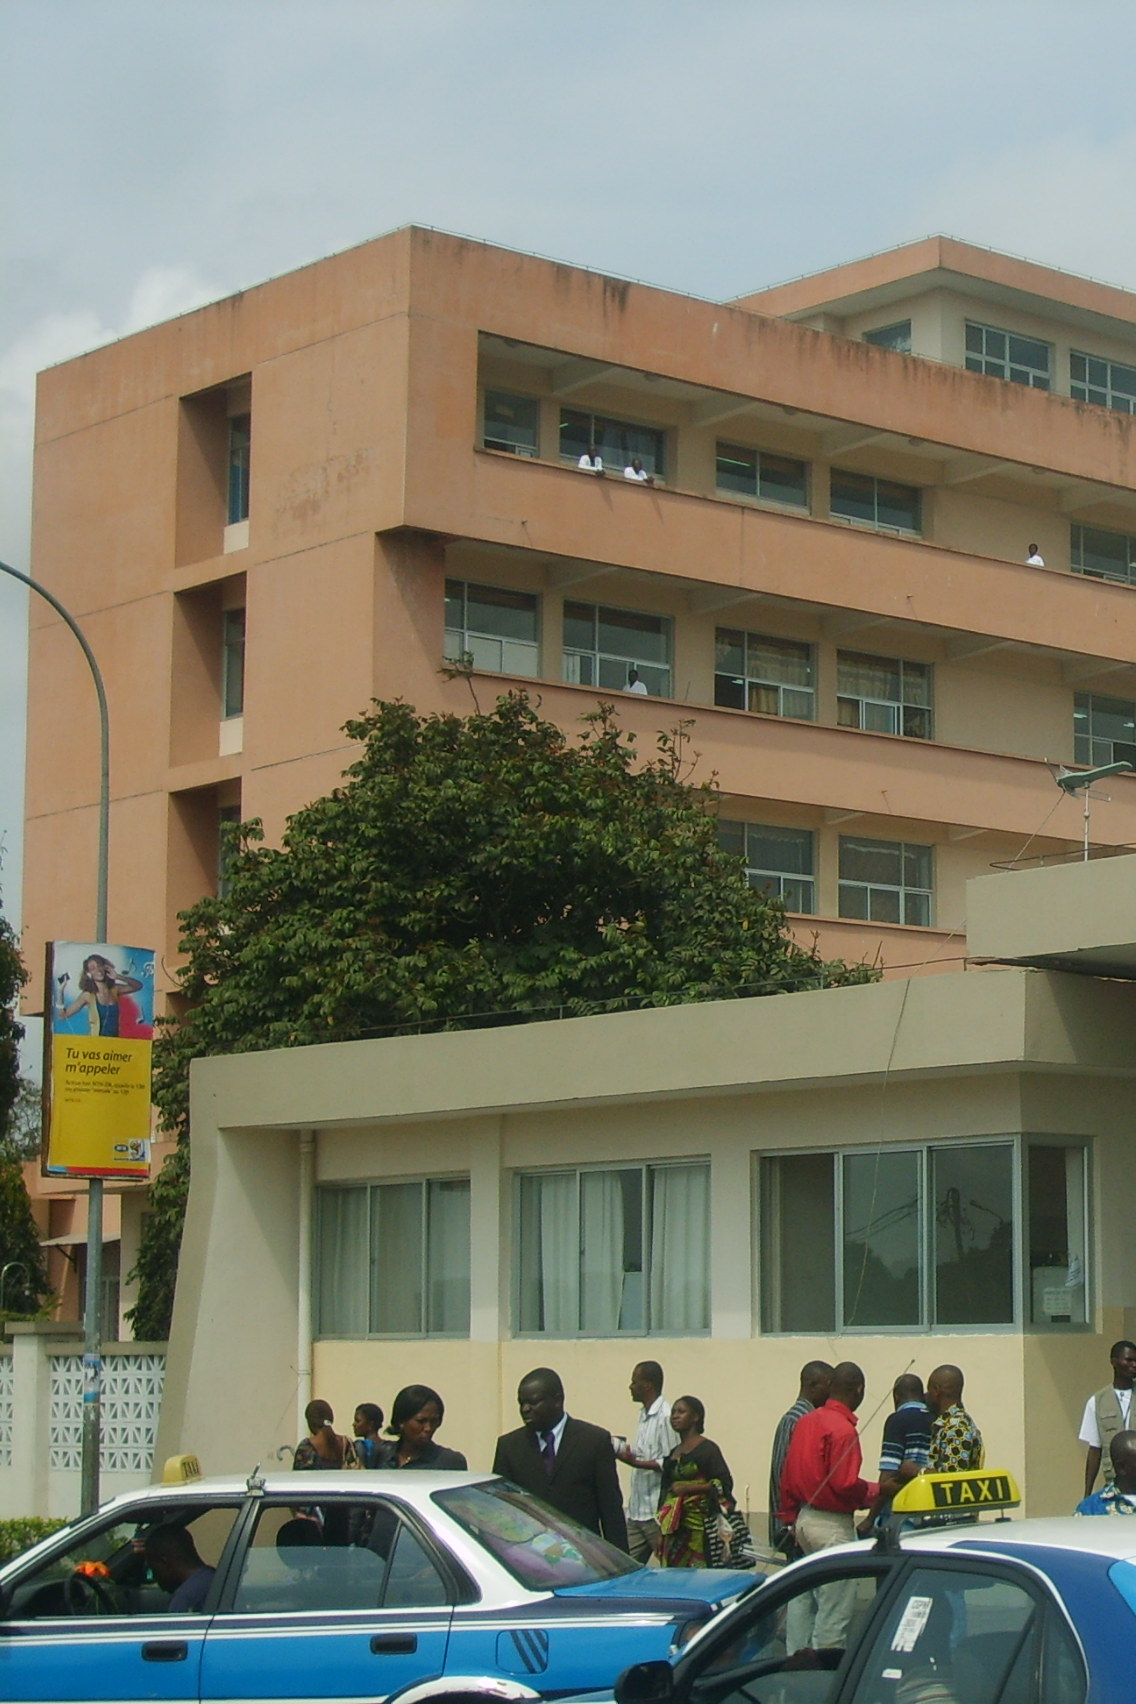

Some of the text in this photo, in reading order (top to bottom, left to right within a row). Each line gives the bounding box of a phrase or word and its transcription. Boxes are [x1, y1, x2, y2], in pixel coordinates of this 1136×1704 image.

[66, 1048, 132, 1062] Tu vas aimer
[65, 1062, 120, 1076] m'appeler
[940, 1478, 1004, 1504] TAXI
